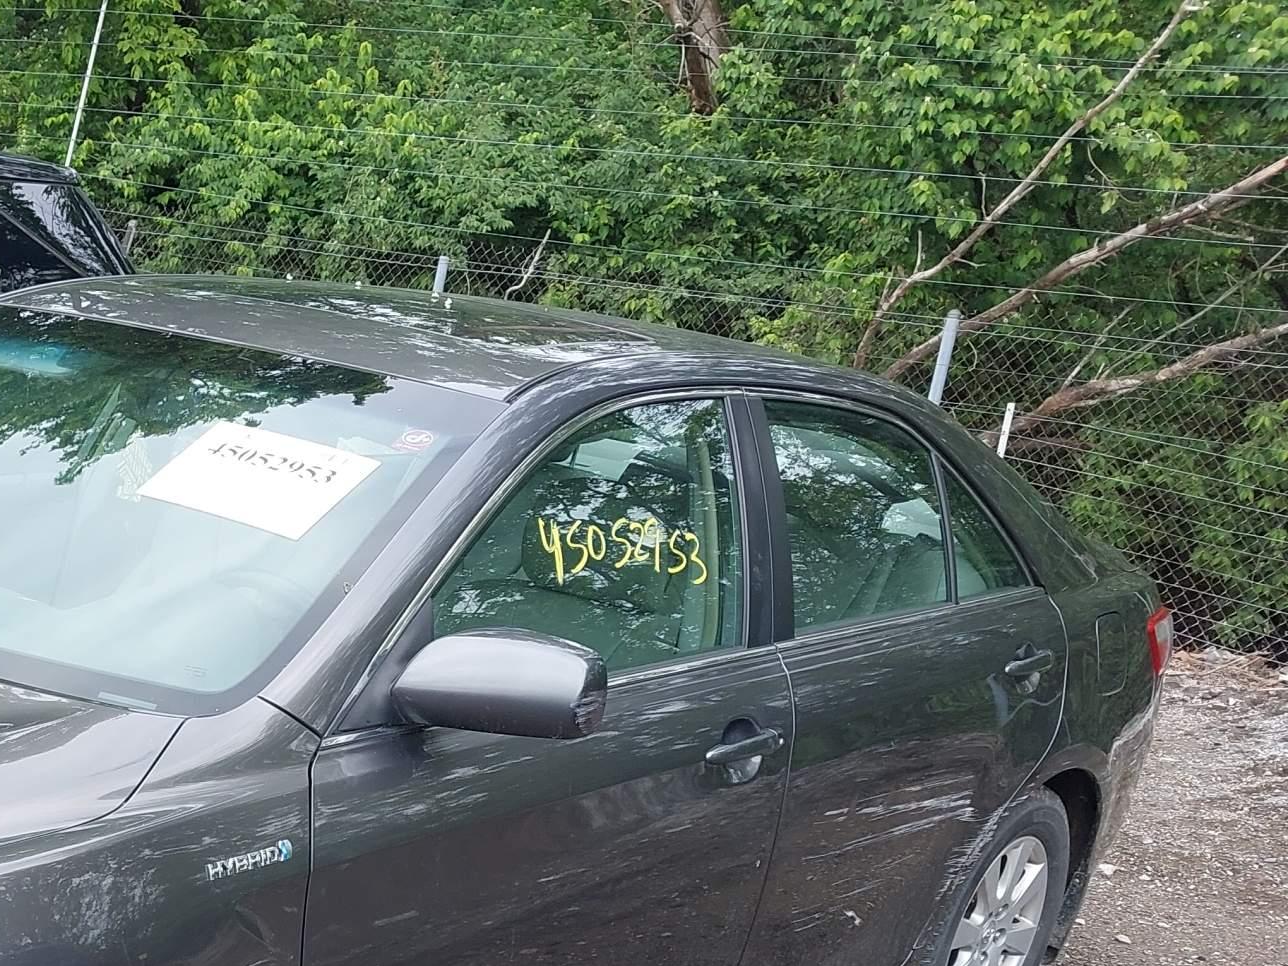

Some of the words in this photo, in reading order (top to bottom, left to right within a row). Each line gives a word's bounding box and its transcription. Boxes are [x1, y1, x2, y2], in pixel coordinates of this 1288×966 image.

[208, 442, 337, 483] 45052953
[537, 516, 709, 586] 45052953
[205, 845, 280, 881] HYBRID
